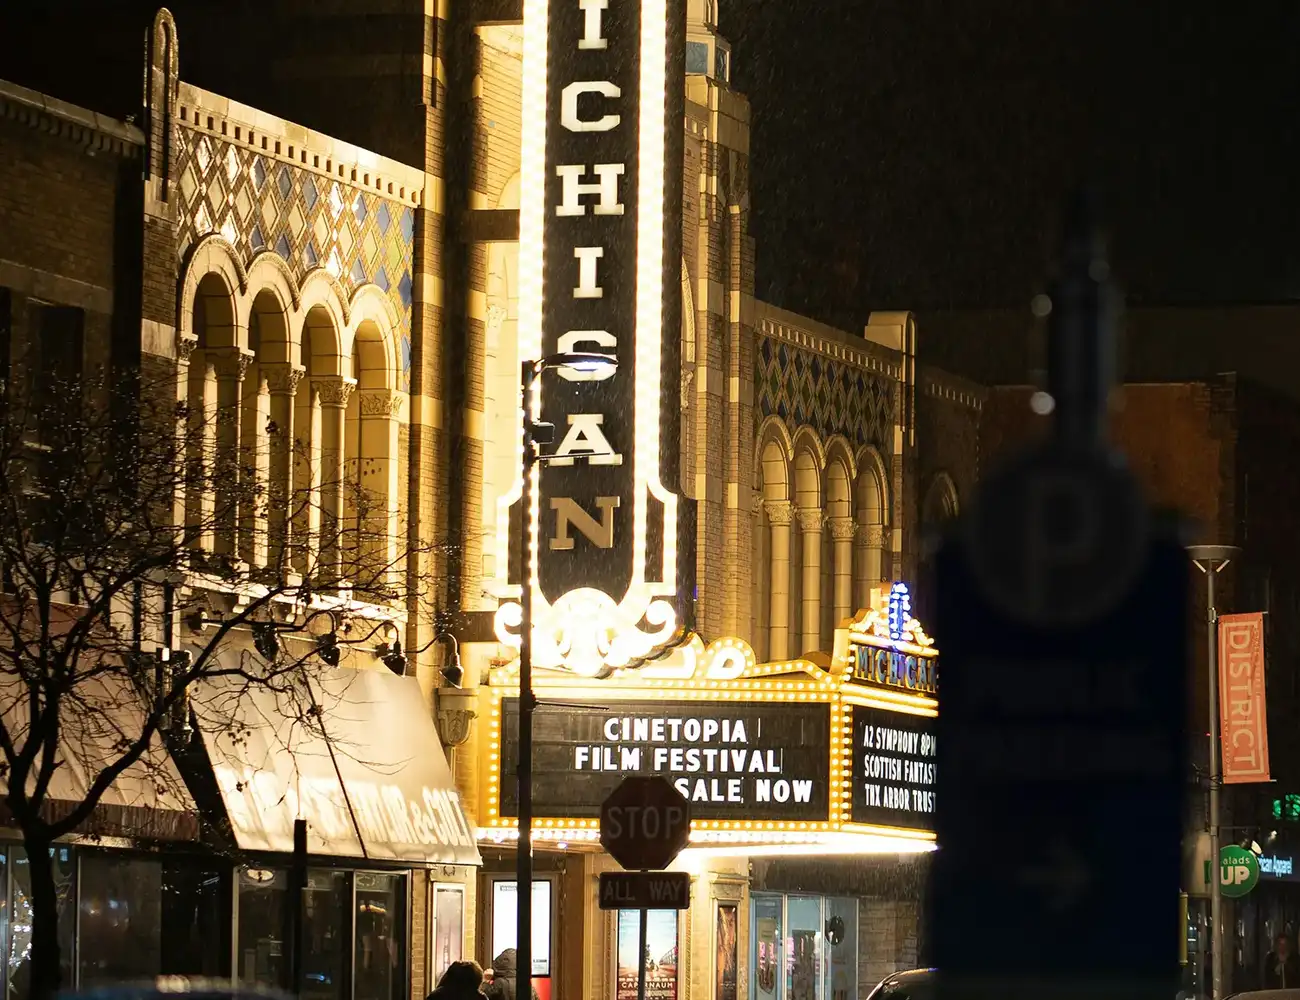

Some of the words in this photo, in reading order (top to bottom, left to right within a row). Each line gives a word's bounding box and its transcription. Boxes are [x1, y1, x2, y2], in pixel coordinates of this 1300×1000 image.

[855, 644, 937, 694] MICHIGAN
[1229, 630, 1256, 768] DISTRICT
[604, 717, 748, 742] CINETOPIA
[863, 725, 874, 748] A2
[876, 726, 918, 755] SYMPHONY
[574, 746, 641, 771] FILM
[653, 747, 781, 774] FESTIVAL
[864, 754, 901, 781] SCOTTISH
[904, 760, 937, 785] FANTASY
[674, 778, 742, 803] SALE
[756, 780, 813, 803] NOW
[883, 786, 910, 811] ARBOR
[912, 789, 937, 813] TRUST
[608, 805, 683, 840] STOP
[1222, 856, 1250, 865] alads
[1220, 865, 1250, 886] UP
[603, 880, 636, 901] ALL
[648, 880, 683, 901] WAY
